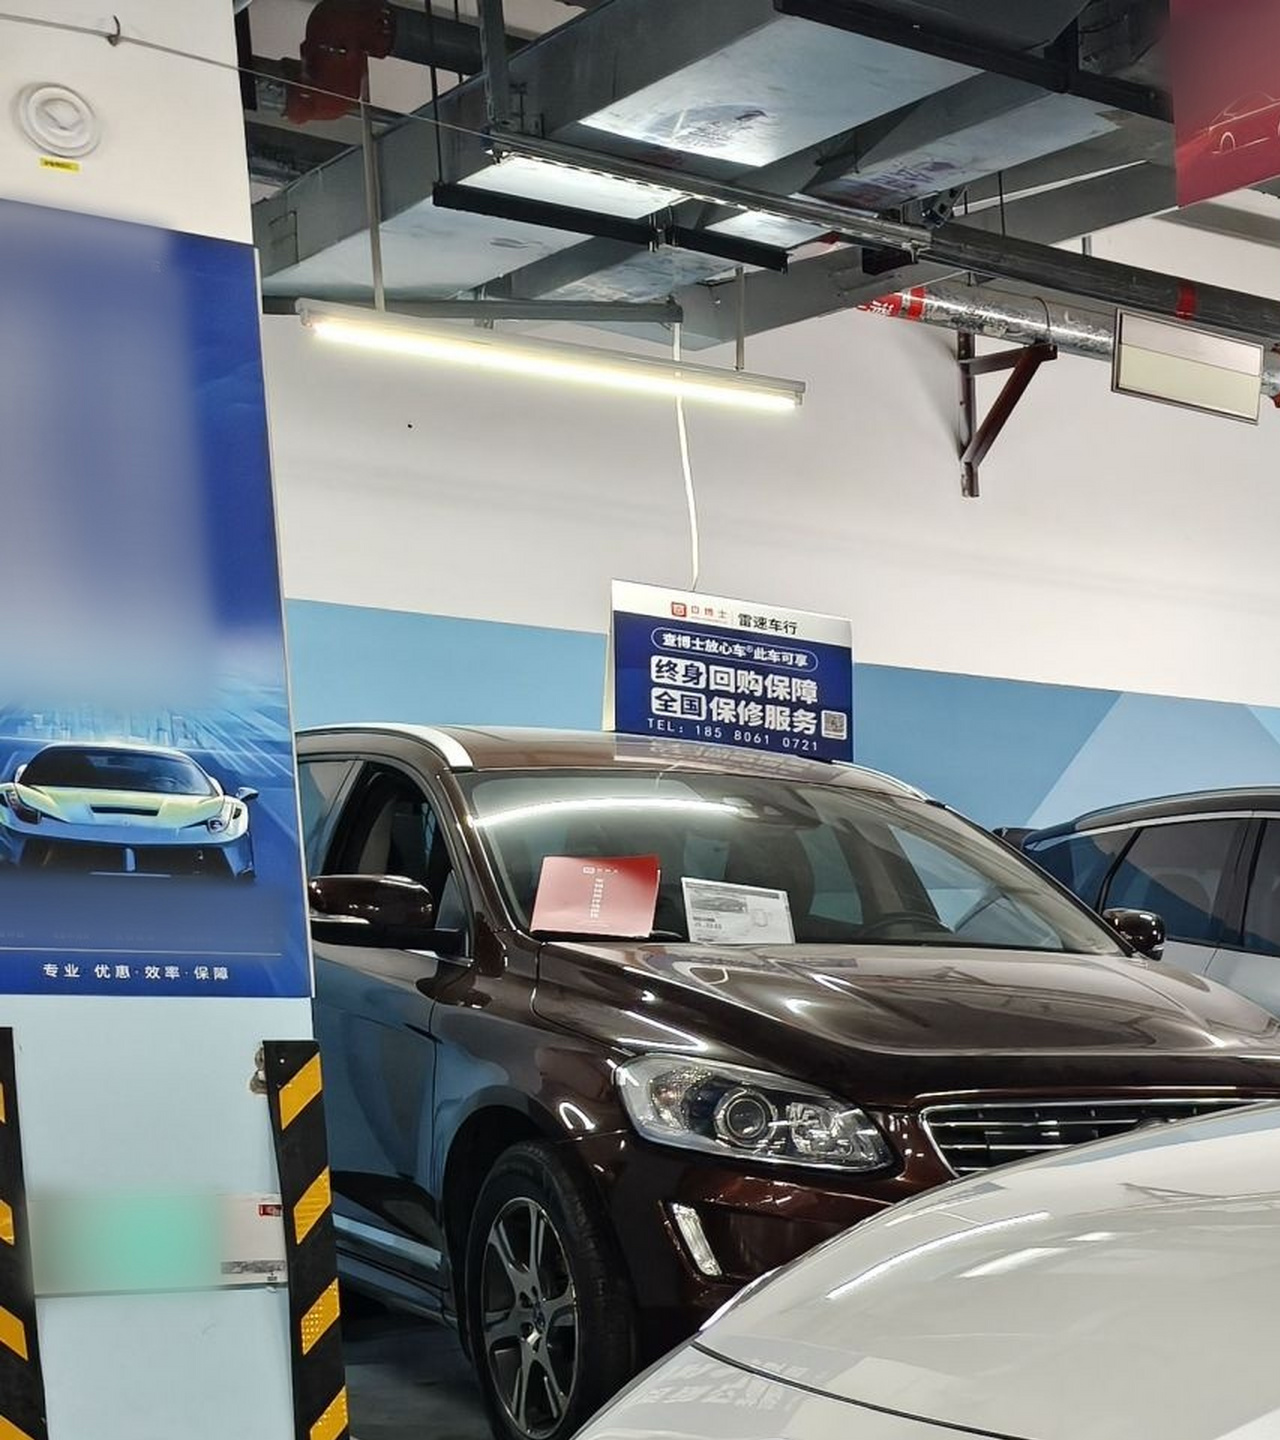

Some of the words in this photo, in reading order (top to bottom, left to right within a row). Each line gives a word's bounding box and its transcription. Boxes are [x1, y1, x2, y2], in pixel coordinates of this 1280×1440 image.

[695, 725, 723, 738] 185
[734, 730, 770, 744] 8061
[782, 737, 818, 751] 0721
